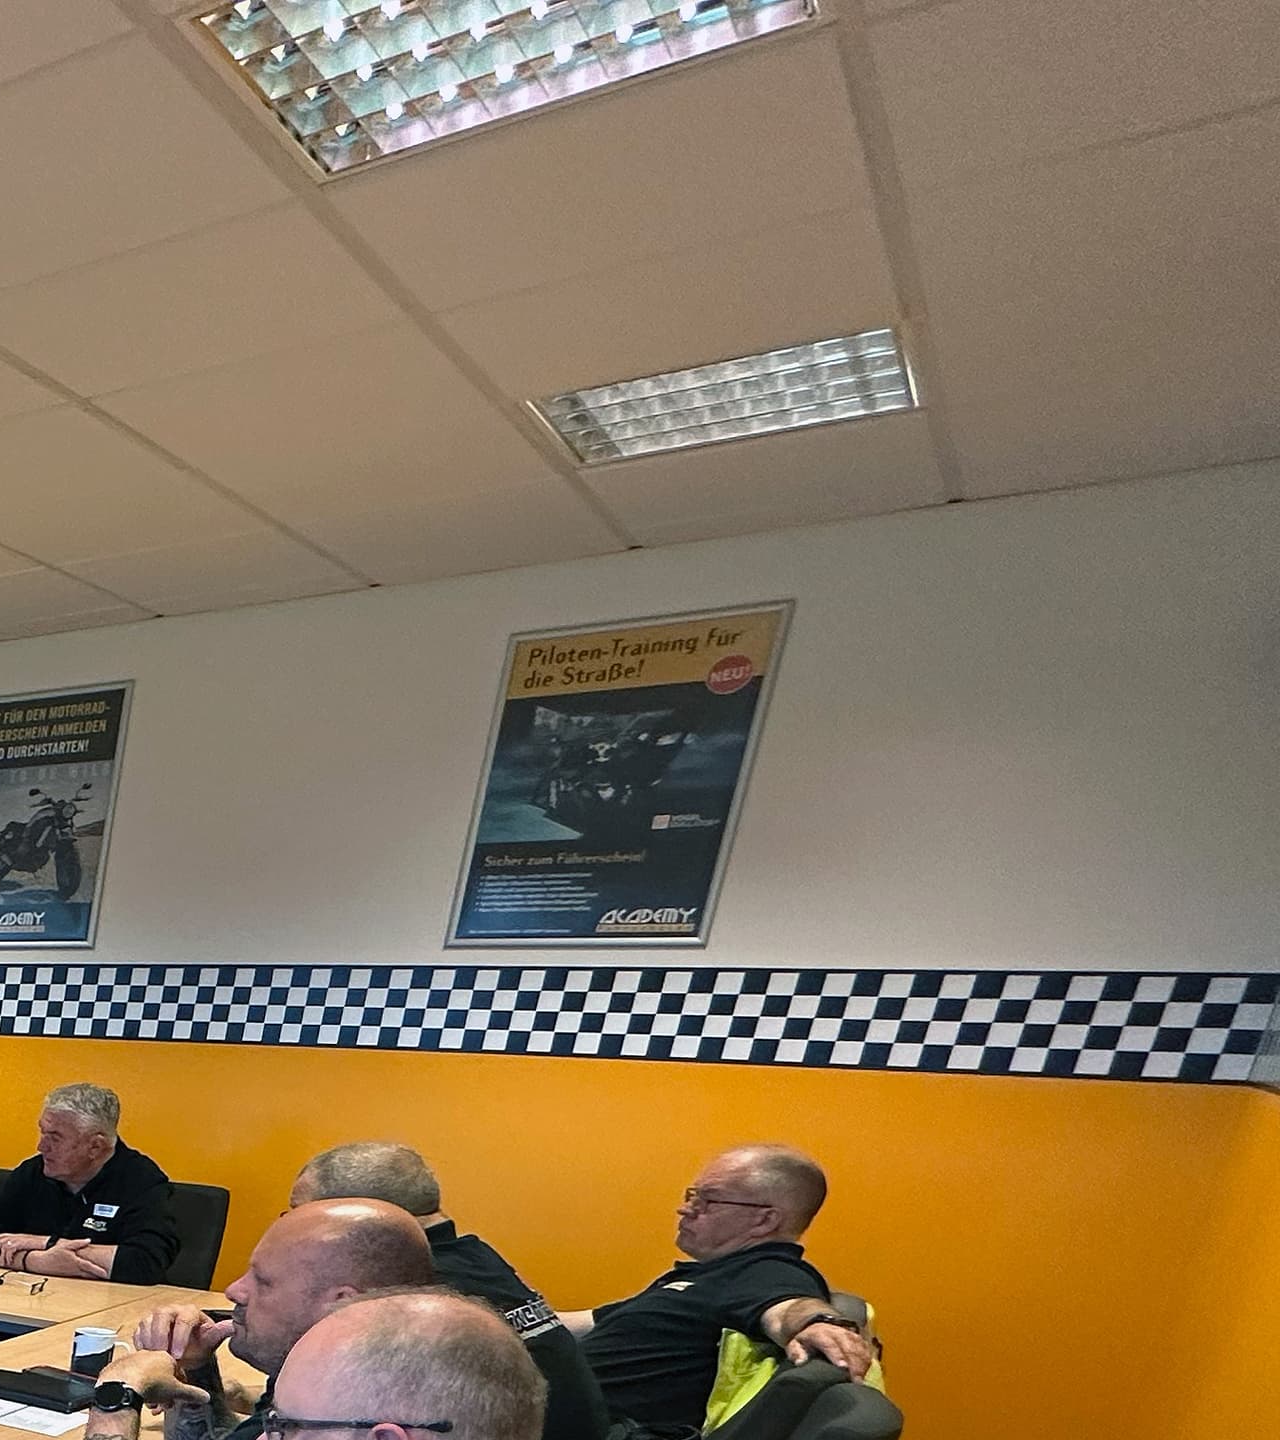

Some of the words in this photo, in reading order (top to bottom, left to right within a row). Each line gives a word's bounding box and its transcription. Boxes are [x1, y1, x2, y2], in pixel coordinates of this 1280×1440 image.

[528, 637, 697, 667] Piloten-Training
[524, 671, 553, 689] die
[561, 660, 644, 685] Straße!
[25, 708, 47, 722] DEN
[48, 701, 111, 719] MOTORRAD-
[49, 720, 107, 735] ANMELDEN
[6, 739, 90, 758] DURCHSTARTEN!
[599, 907, 697, 923] ACADEMY
